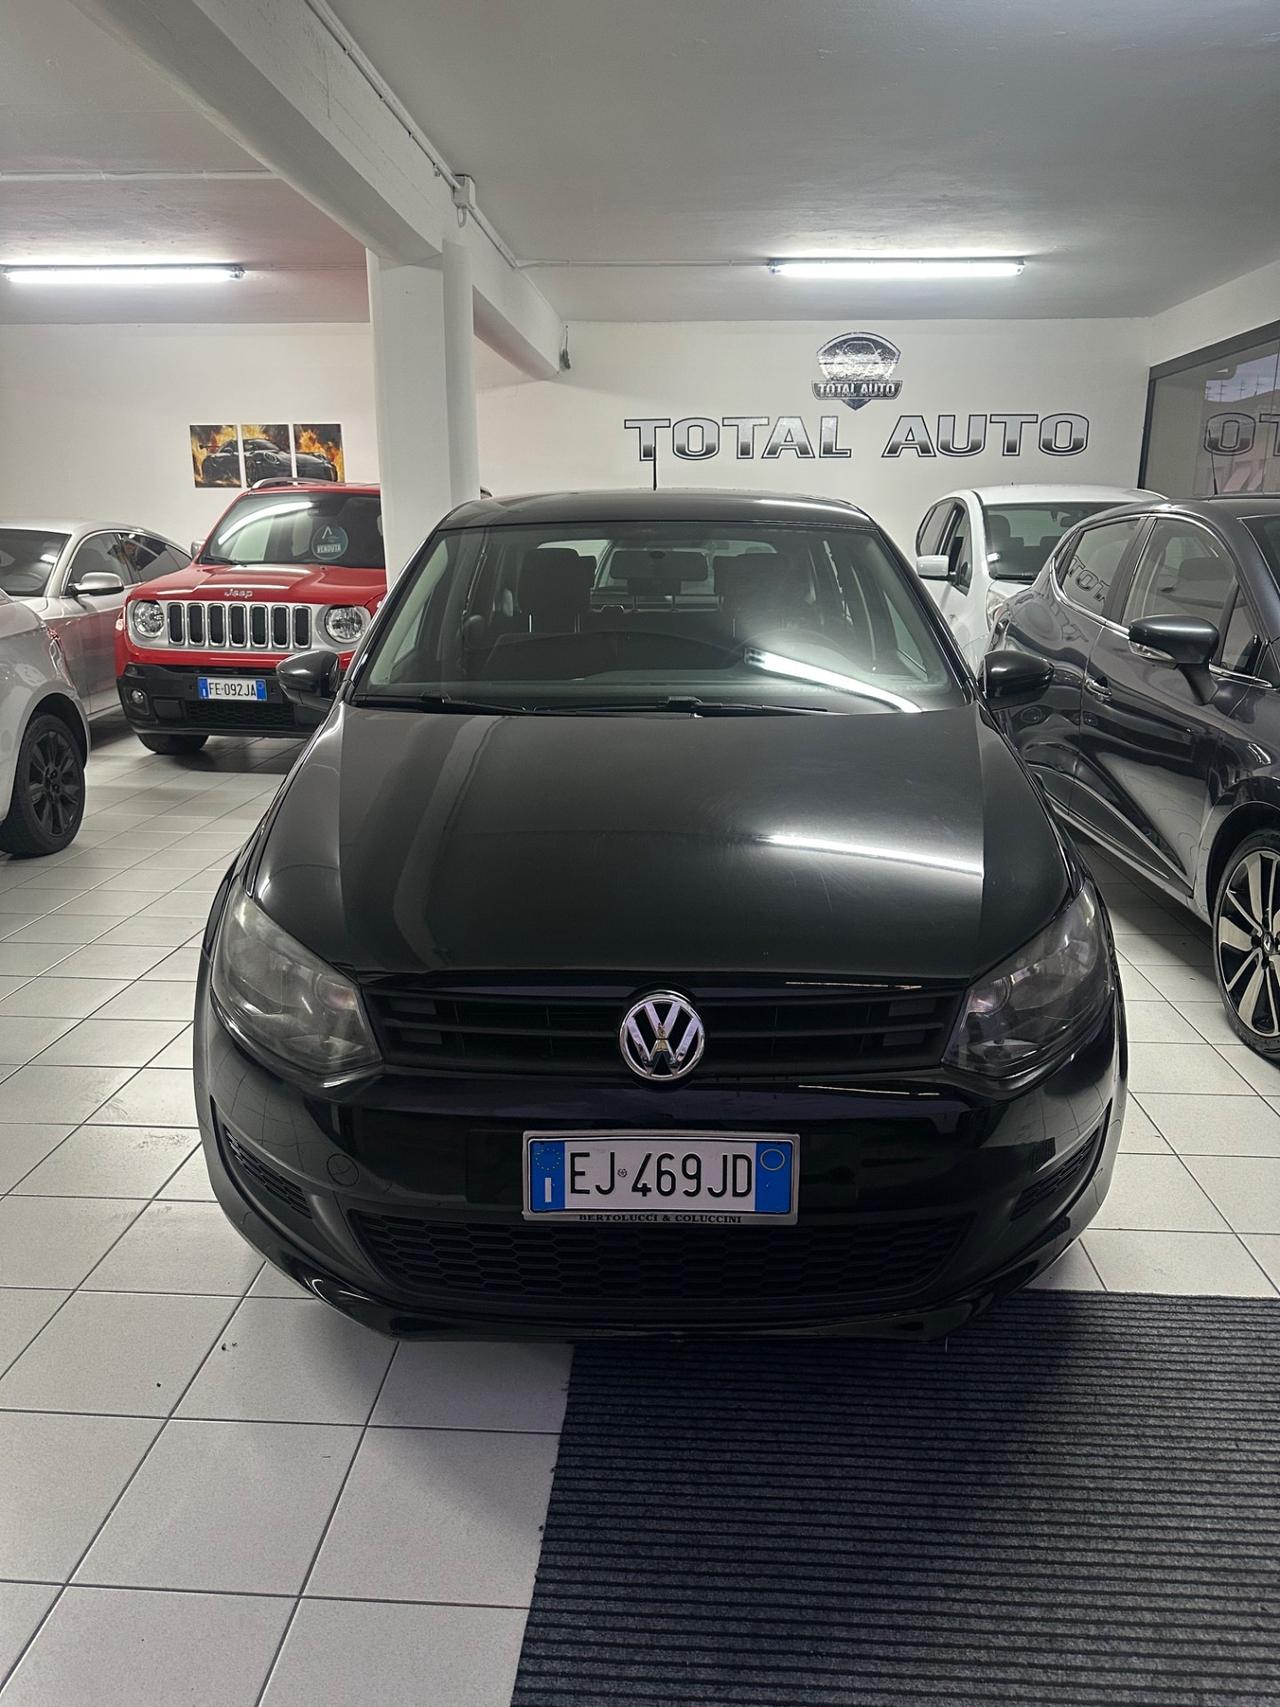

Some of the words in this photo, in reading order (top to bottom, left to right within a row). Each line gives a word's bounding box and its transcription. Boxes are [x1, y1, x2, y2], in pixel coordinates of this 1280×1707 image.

[818, 383, 857, 397] TOTAL
[860, 383, 896, 397] AUTO
[624, 416, 852, 461] TOTAL
[881, 412, 1090, 457] AUTO
[224, 588, 253, 599] Jeep
[631, 1153, 752, 1198] 469JD
[578, 1213, 658, 1223] BERTOLUCCI
[662, 1215, 671, 1223] &
[675, 1214, 742, 1224] COLUCCINI
